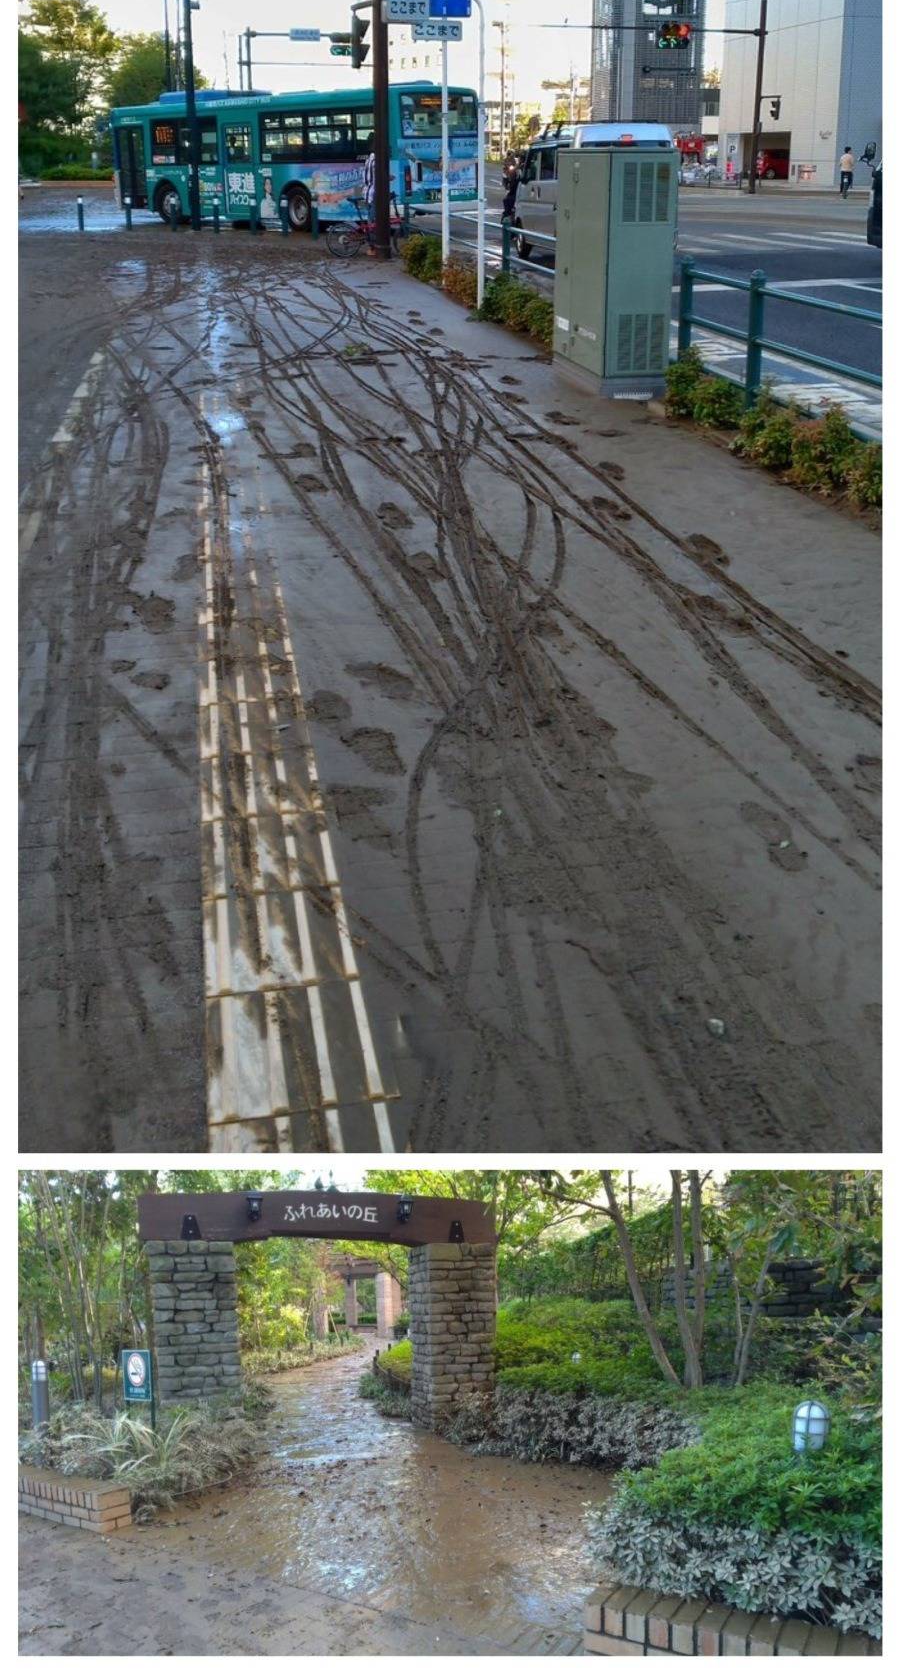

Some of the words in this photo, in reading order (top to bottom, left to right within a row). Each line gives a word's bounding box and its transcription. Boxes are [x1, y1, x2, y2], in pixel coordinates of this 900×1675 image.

[390, 0, 427, 16] ここまで
[414, 22, 461, 38] ここまで
[227, 171, 256, 194] 東進
[283, 1203, 379, 1223] ふれあいの丘
